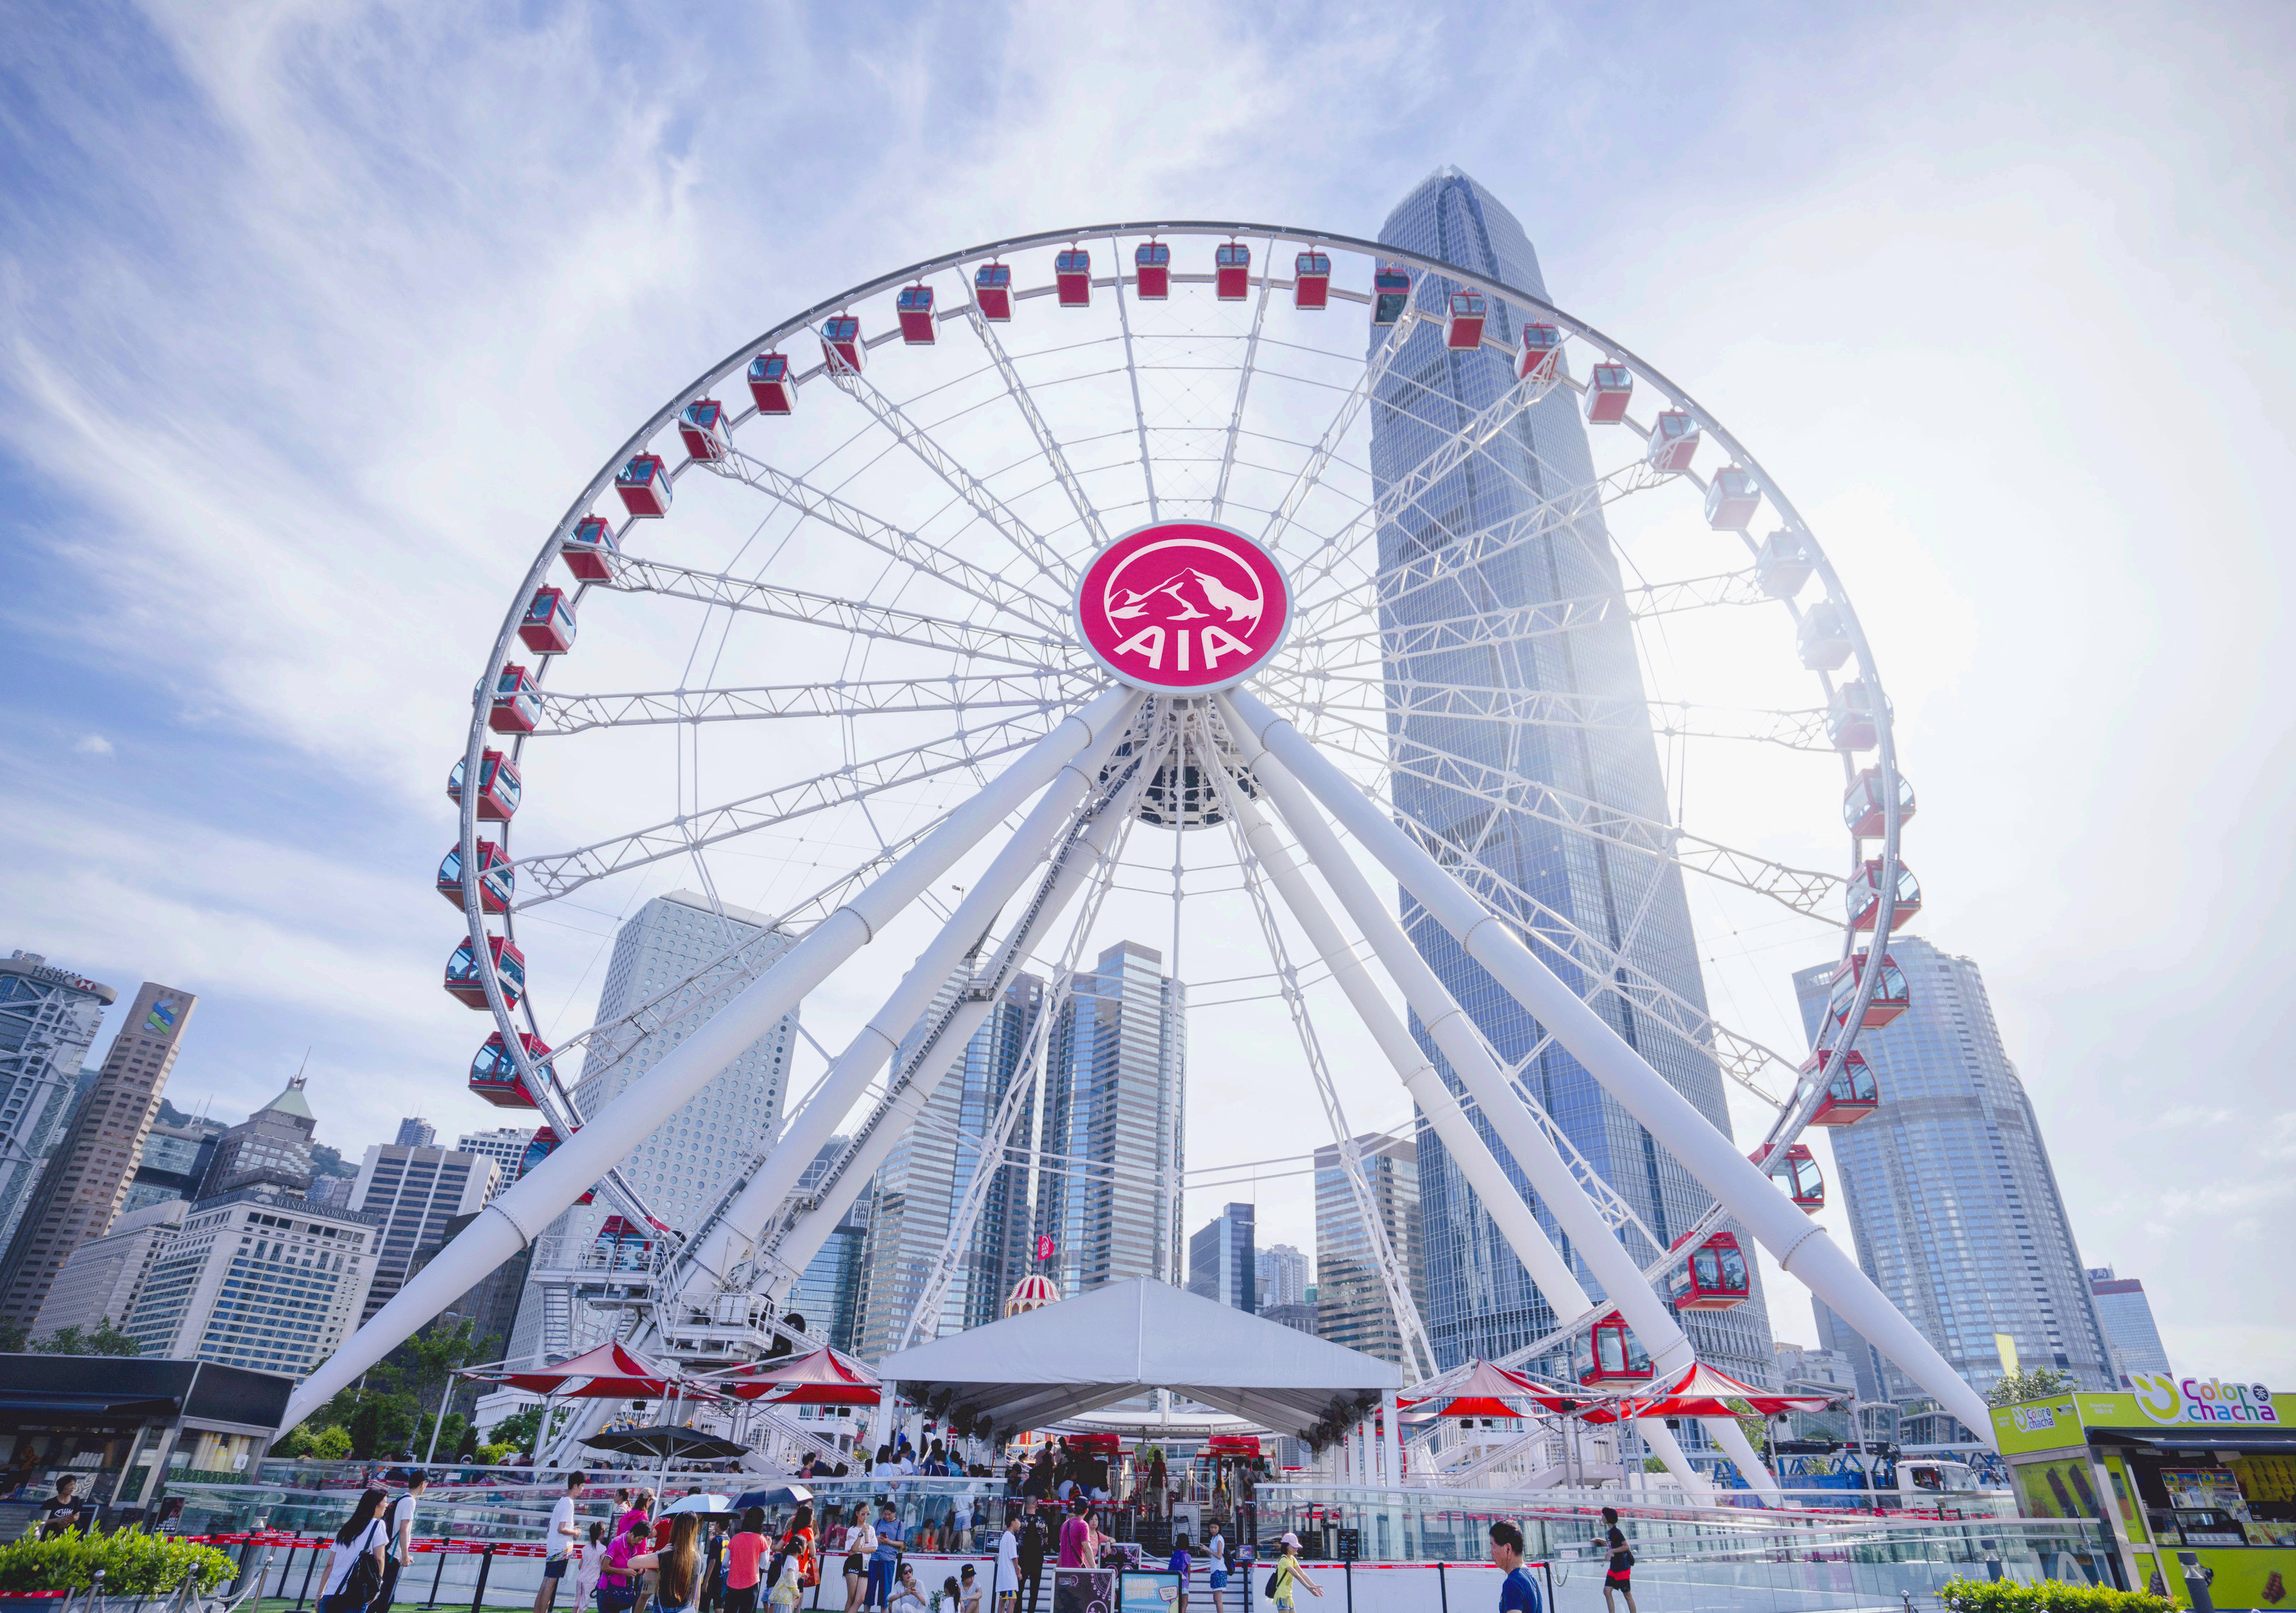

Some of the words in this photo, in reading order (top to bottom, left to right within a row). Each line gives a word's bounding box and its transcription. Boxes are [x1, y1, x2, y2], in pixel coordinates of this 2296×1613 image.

[1113, 625, 1253, 671] AIA
[30, 965, 75, 985] HSBC
[274, 1198, 325, 1216] MANDARIN
[327, 1209, 370, 1224] ORIENTAL
[2182, 1380, 2248, 1401] Color
[2254, 1385, 2268, 1400] 茶
[2027, 1409, 2046, 1420] Color
[2188, 1405, 2276, 1421] chacha
[2029, 1417, 2054, 1430] chacha
